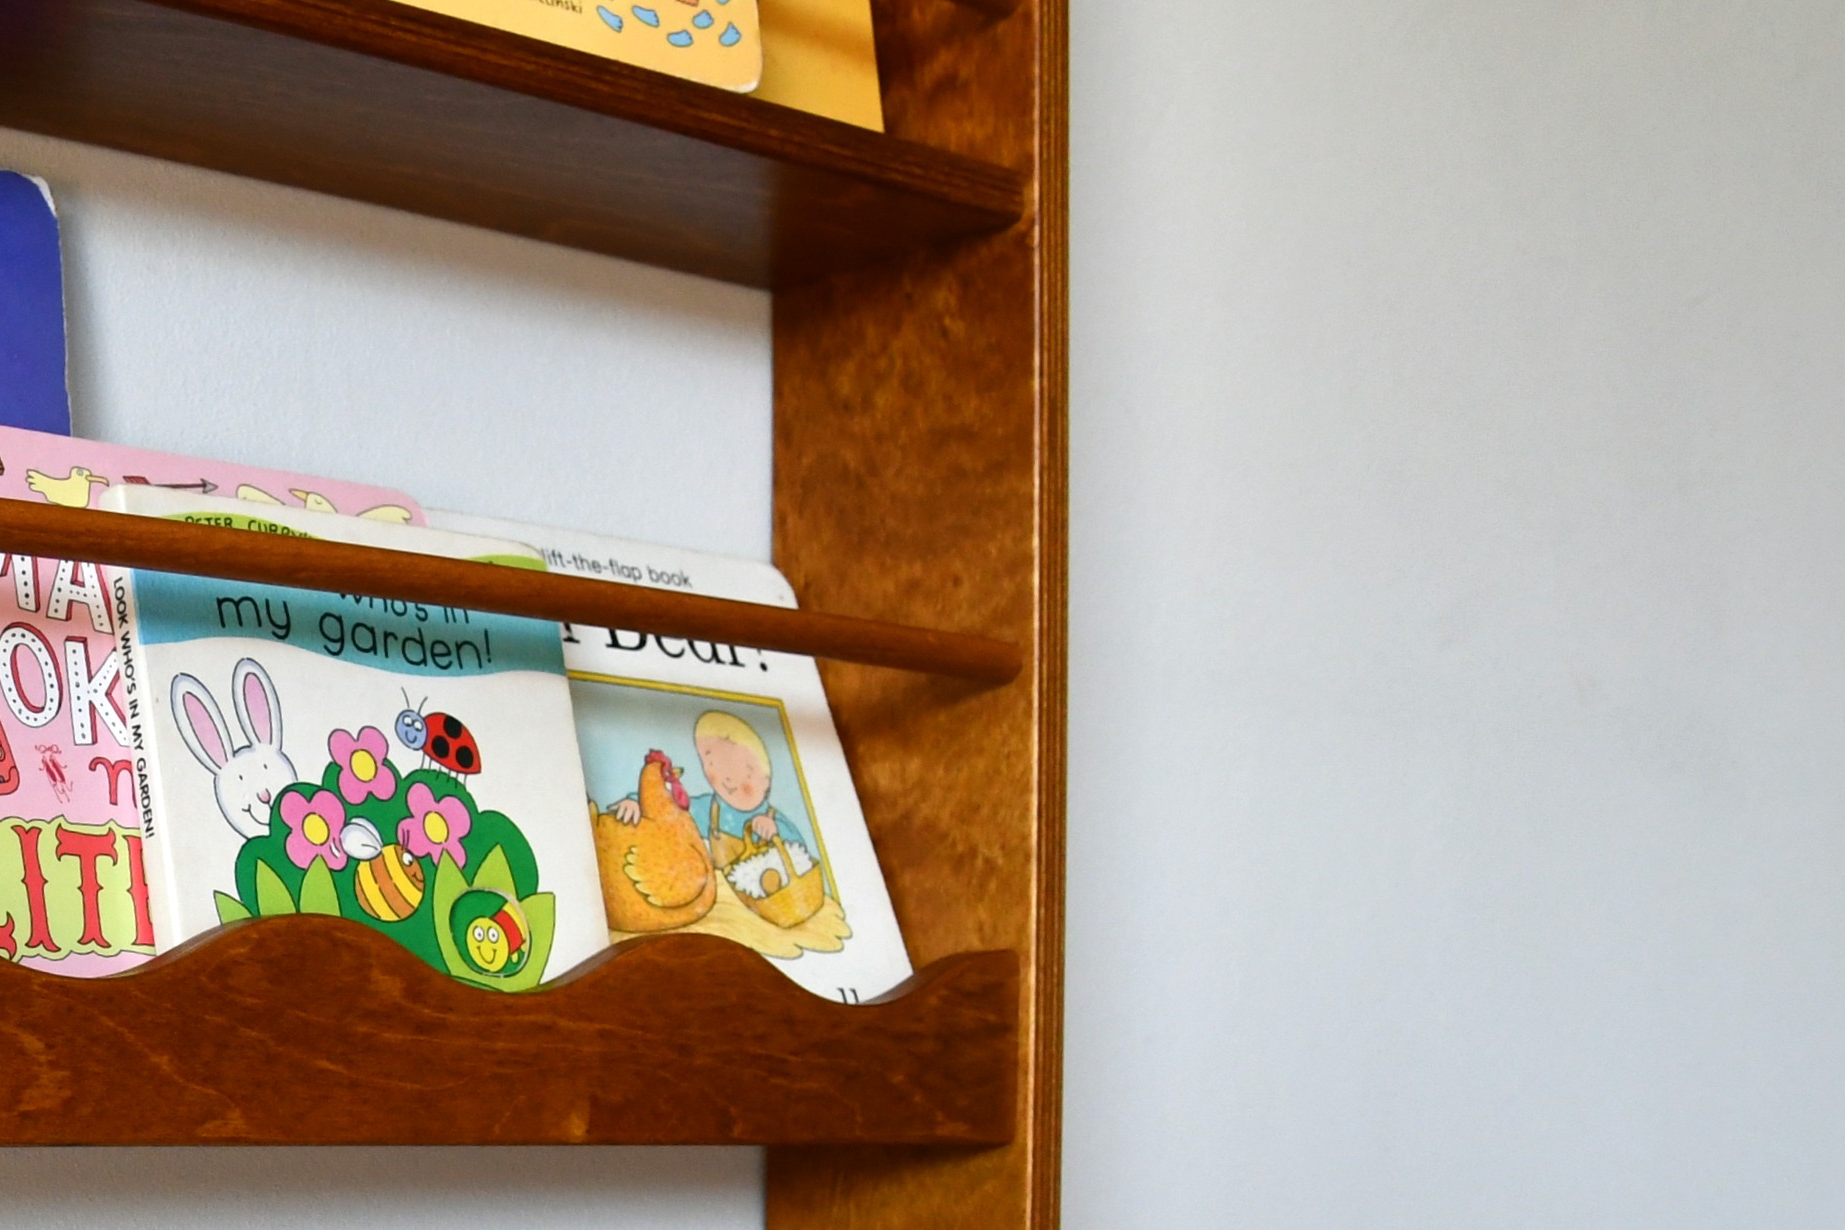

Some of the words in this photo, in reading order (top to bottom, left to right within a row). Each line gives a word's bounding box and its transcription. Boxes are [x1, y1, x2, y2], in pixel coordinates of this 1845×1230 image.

[648, 567, 692, 589] book
[113, 577, 130, 629] LOOK
[215, 595, 291, 640] my
[319, 611, 493, 671] garden!
[604, 627, 769, 671] ear
[119, 634, 138, 694] WHO'S
[129, 698, 139, 720] IN
[131, 723, 144, 752] MY
[136, 757, 155, 839] GARDEN!
